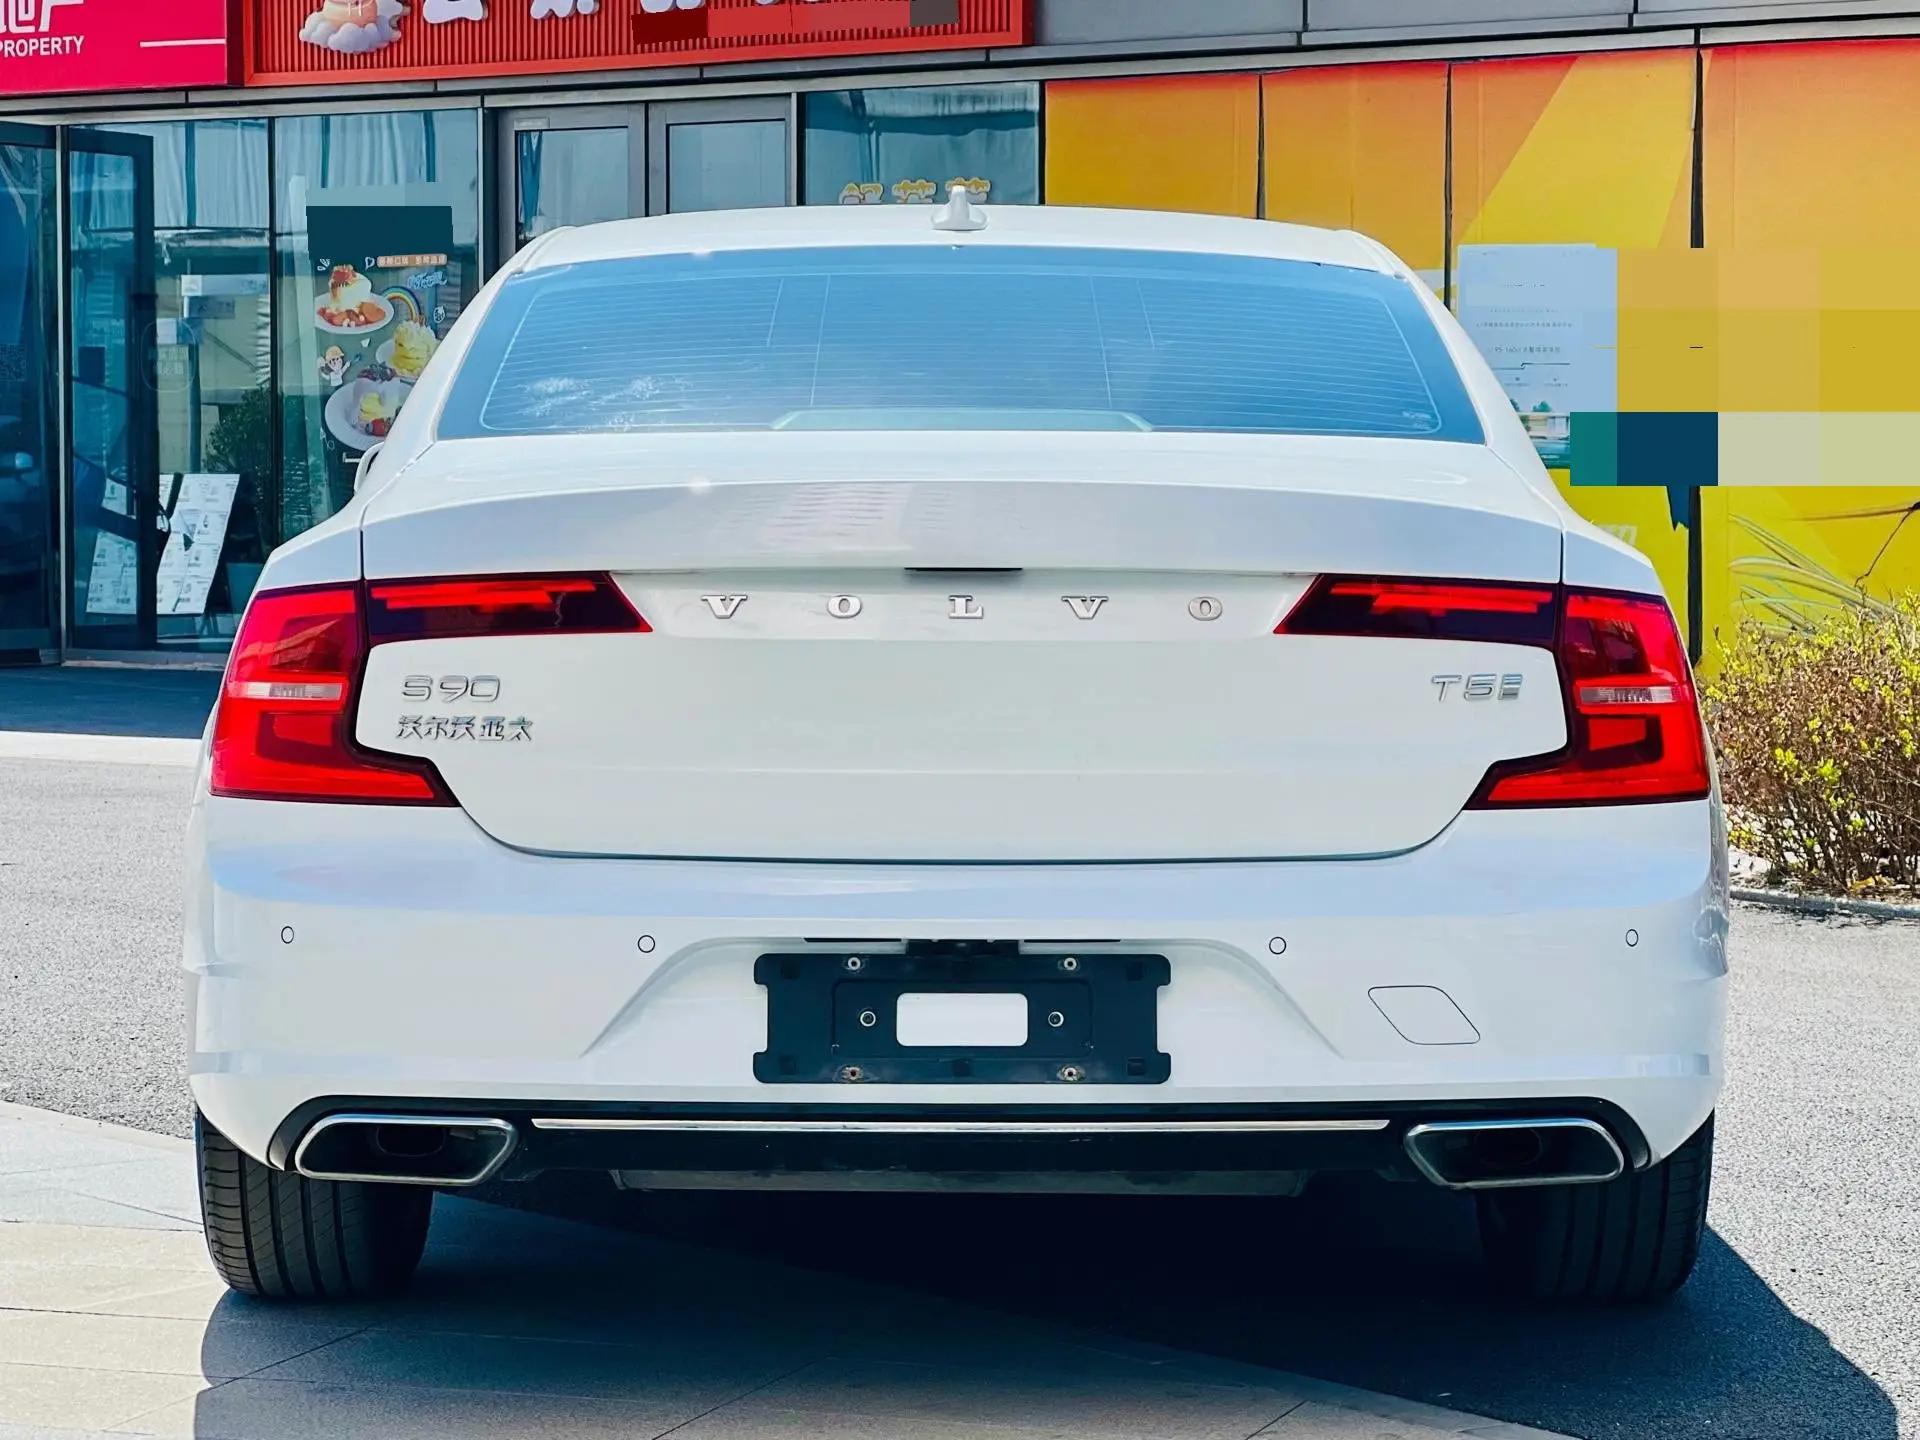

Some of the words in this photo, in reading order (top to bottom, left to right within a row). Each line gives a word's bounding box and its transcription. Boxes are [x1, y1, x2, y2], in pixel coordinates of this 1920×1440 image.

[700, 594, 1223, 621] VOLVO
[402, 674, 501, 703] S90
[396, 712, 533, 742] 沃尔沃亚太
